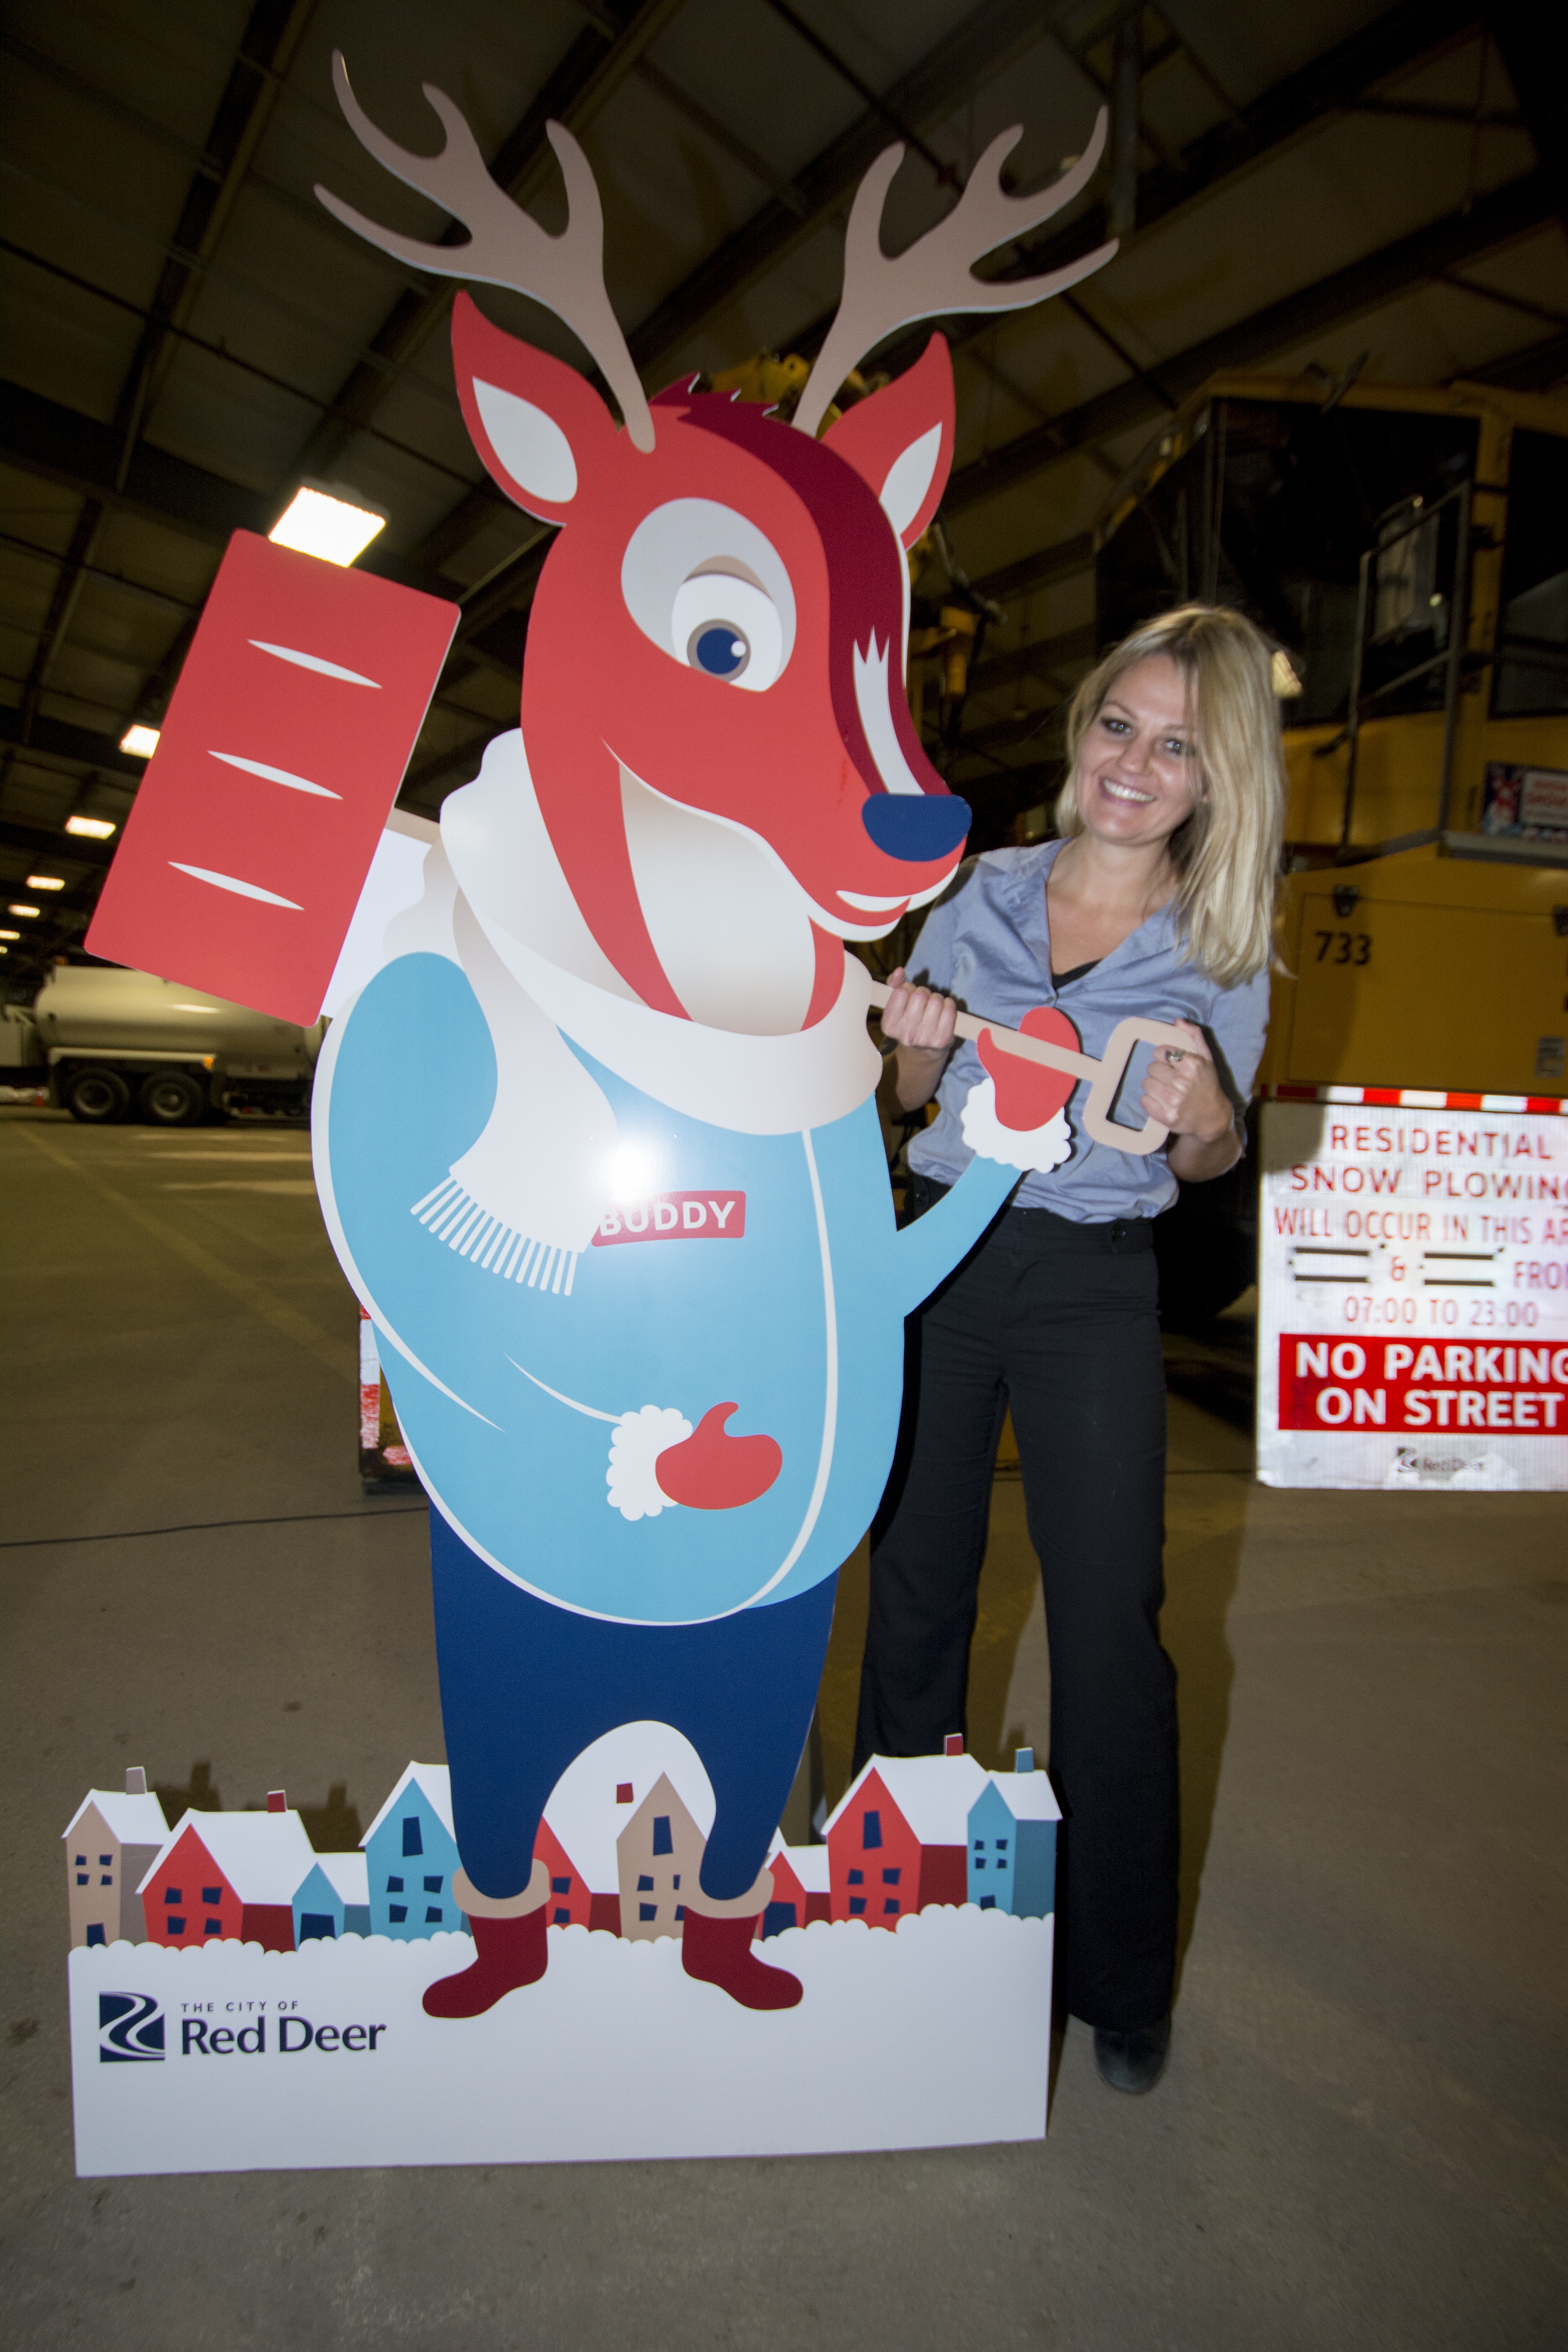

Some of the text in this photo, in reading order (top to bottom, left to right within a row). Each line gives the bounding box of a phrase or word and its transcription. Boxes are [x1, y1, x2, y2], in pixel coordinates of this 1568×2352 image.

[1315, 930, 1372, 965] 733
[1330, 1125, 1553, 1160] RESIDENTIAL
[1291, 1165, 1568, 1200] SNOW PLOWIN
[599, 1200, 736, 1237] BUDDY
[1275, 1207, 1331, 1236] WILL
[1345, 1210, 1430, 1241] OCCUR
[1443, 1213, 1468, 1241] IN
[1481, 1215, 1532, 1244] THIS
[1390, 1256, 1568, 1290] & FRO
[1345, 1296, 1538, 1327] 07:00 TO 23:00
[1296, 1342, 1366, 1379] NO
[1316, 1388, 1565, 1427] ON STREET
[181, 2000, 299, 2013] THE CITY OF
[182, 2016, 387, 2055] Red Deer
